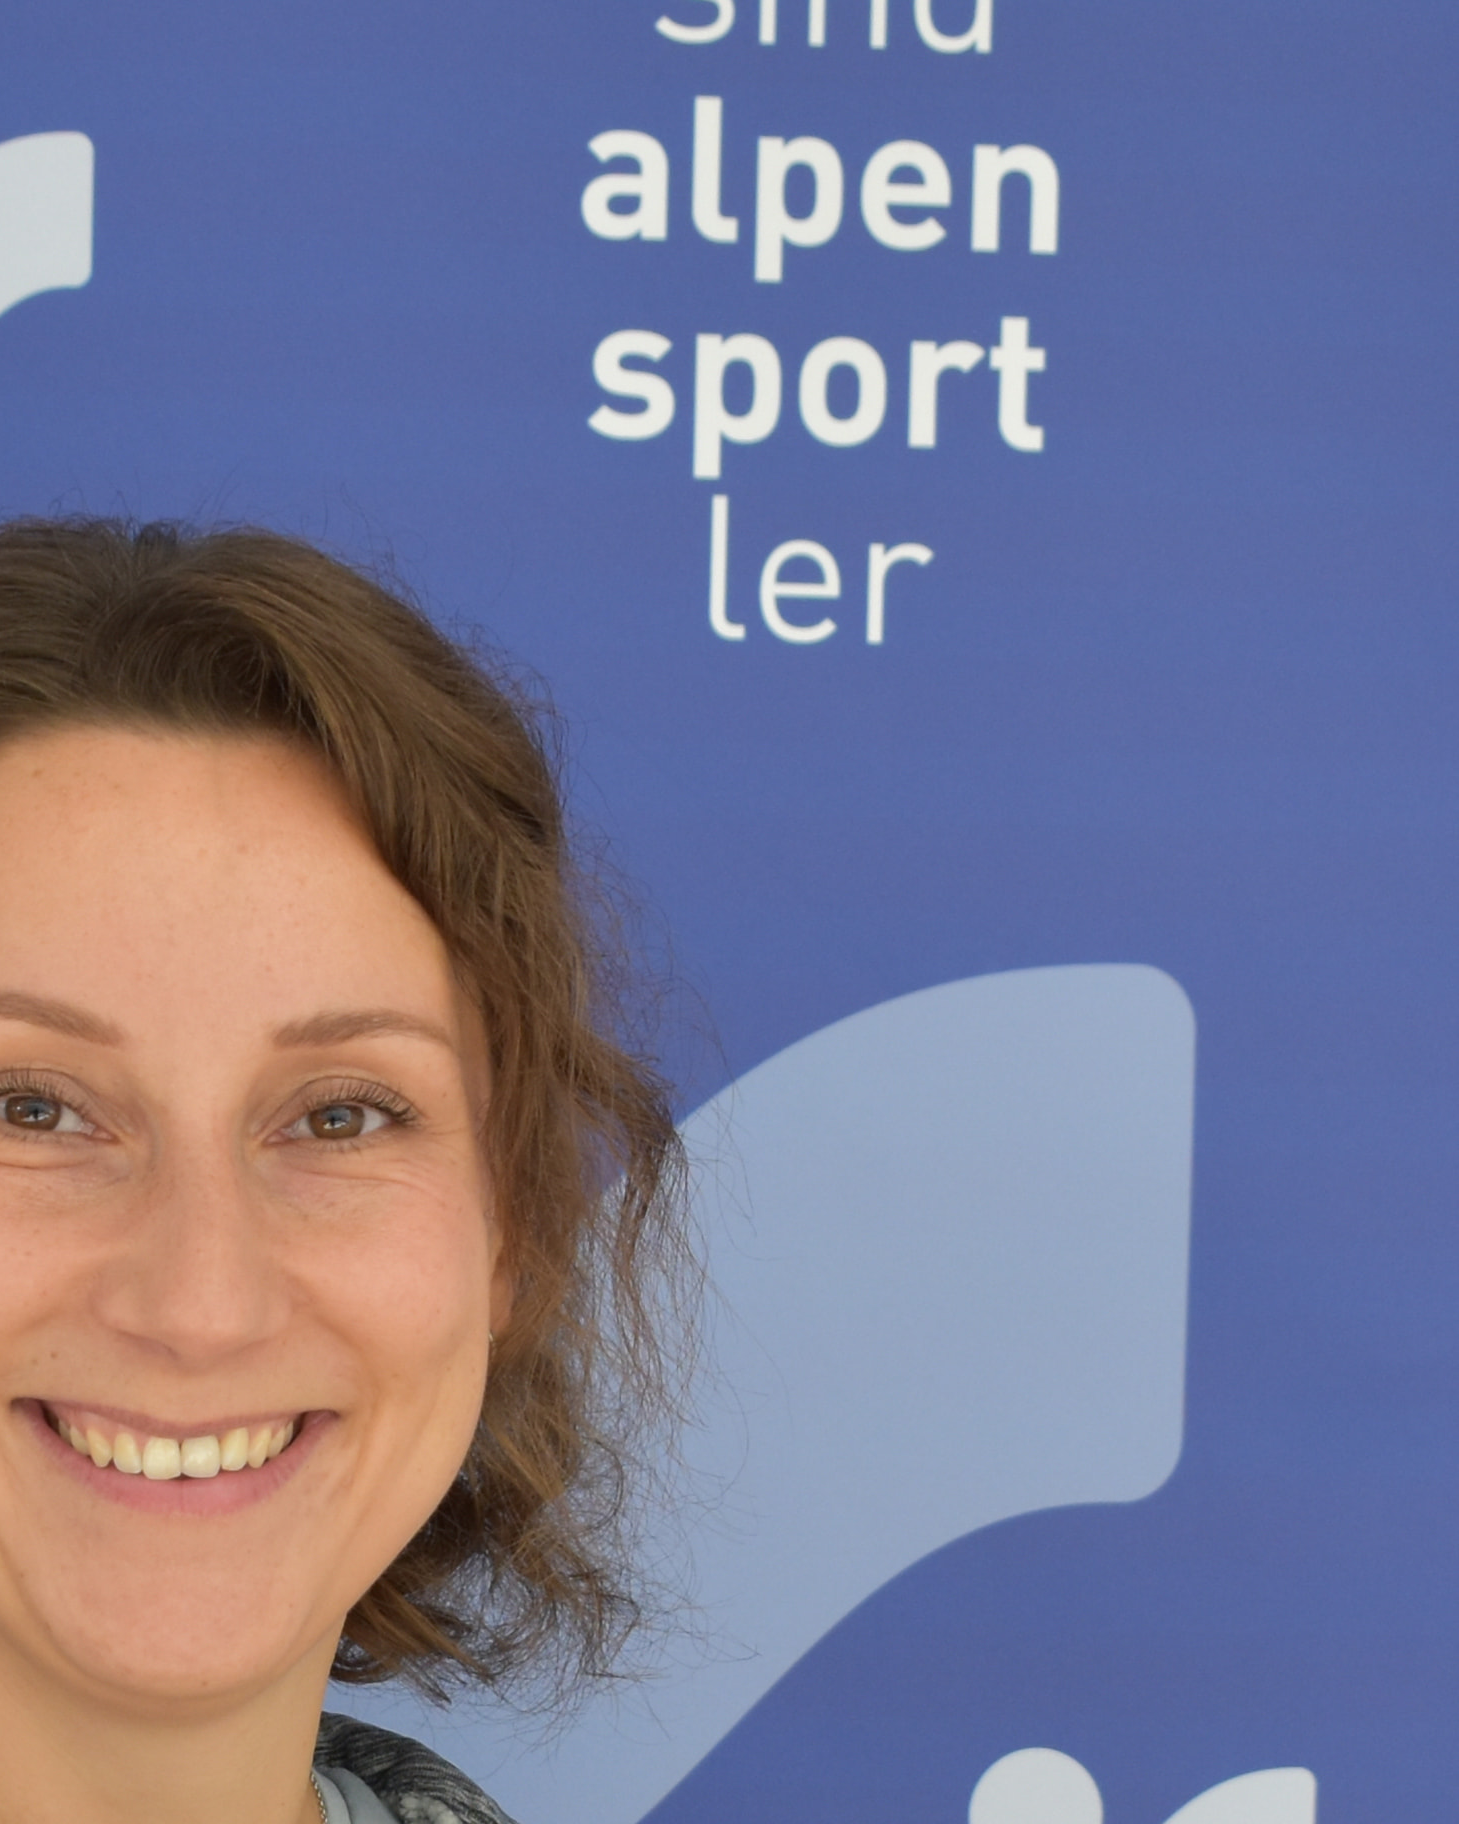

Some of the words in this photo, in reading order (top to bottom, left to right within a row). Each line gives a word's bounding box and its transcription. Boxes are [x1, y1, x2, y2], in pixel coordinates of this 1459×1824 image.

[582, 96, 1058, 281] alpen
[589, 317, 1045, 478] sport
[710, 495, 933, 643] ler
